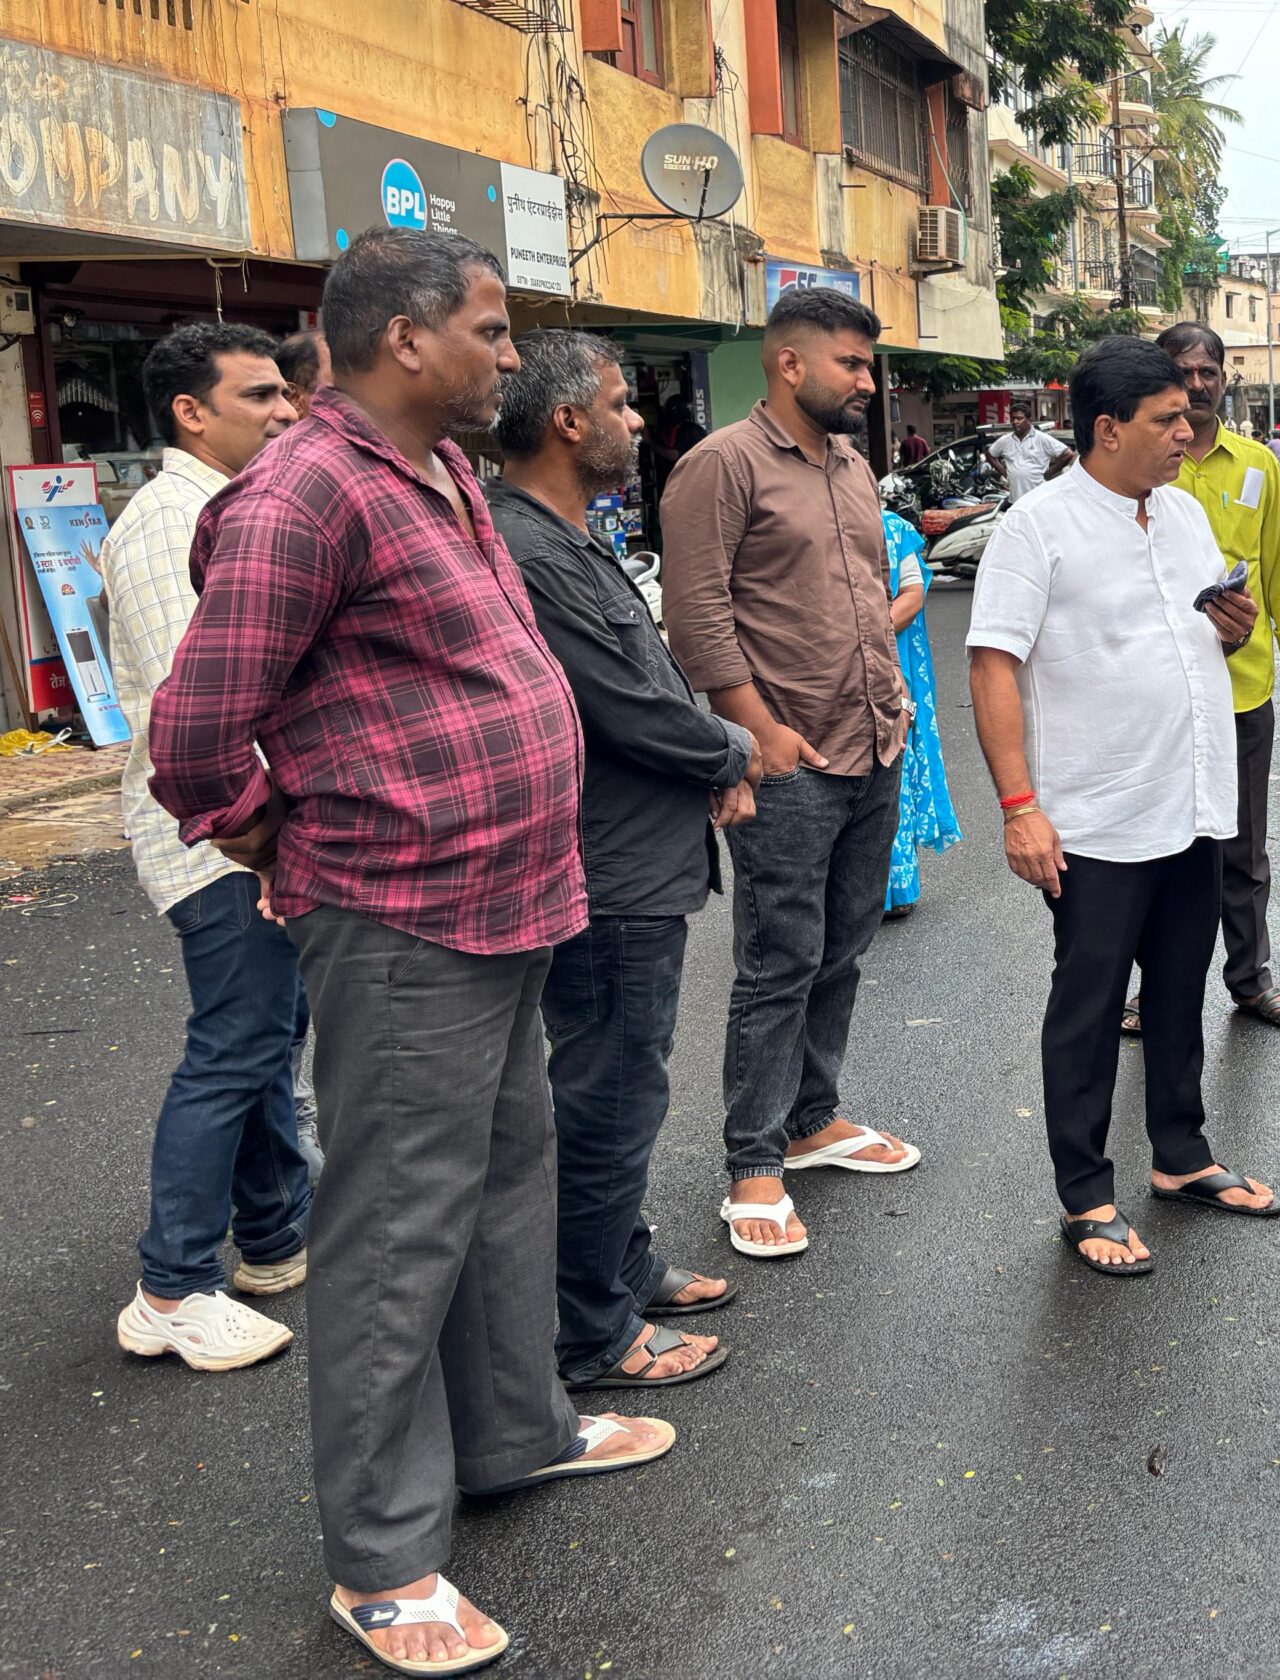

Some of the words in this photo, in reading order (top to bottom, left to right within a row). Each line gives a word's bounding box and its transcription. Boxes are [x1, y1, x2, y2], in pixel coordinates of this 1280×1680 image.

[664, 154, 691, 164] SUN
[386, 185, 425, 220] BPL
[429, 193, 456, 212] Happy
[431, 208, 451, 222] Little
[510, 247, 536, 262] PUNEETH
[536, 251, 567, 268] ENTERPRISE
[69, 511, 102, 528] KENSTAR
